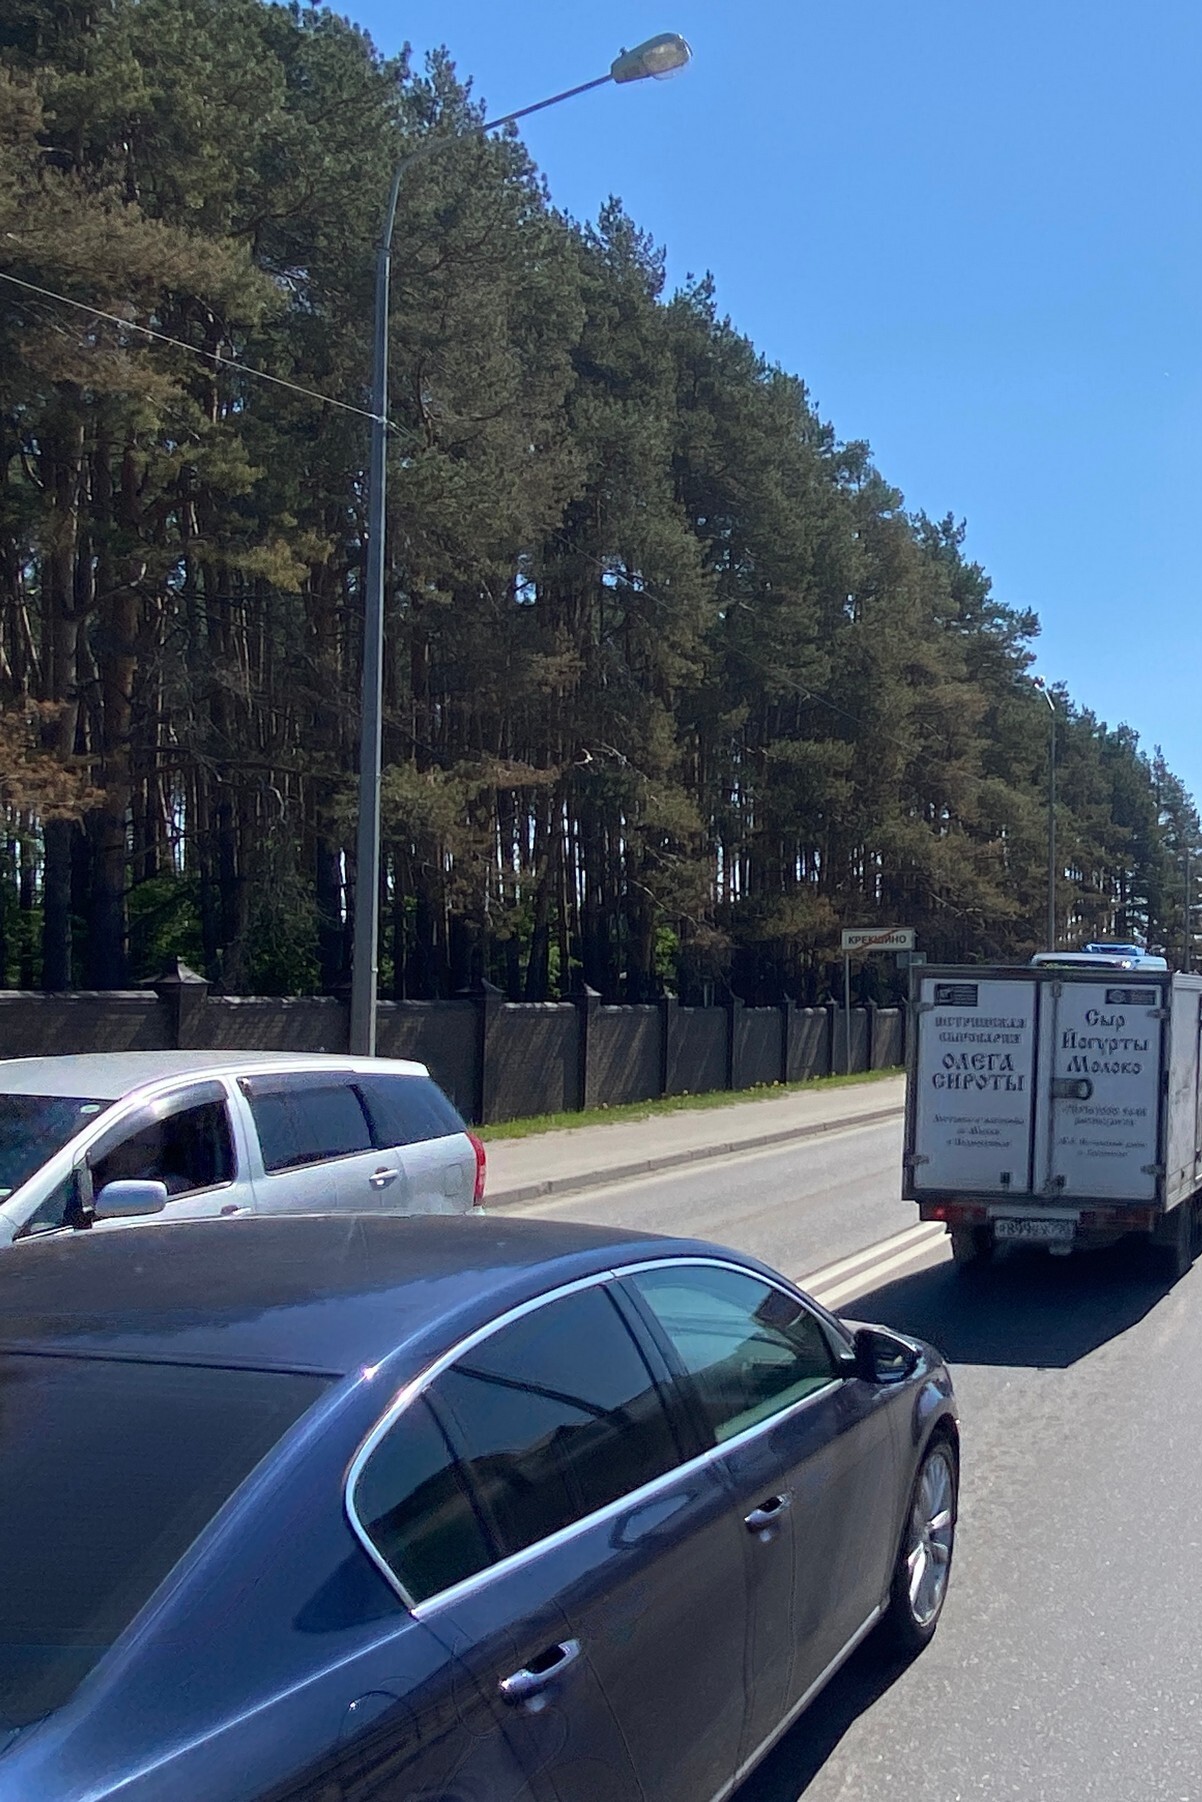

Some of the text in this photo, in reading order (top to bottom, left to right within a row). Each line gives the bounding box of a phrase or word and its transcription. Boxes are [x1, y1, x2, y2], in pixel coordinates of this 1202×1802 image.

[1085, 1009, 1126, 1032] Сыр
[1061, 1028, 1151, 1056] Йогурты
[942, 1053, 1014, 1071] ОЛЕГА
[1067, 1056, 1144, 1075] Молоко
[932, 1072, 1025, 1091] СИРОТЫ
